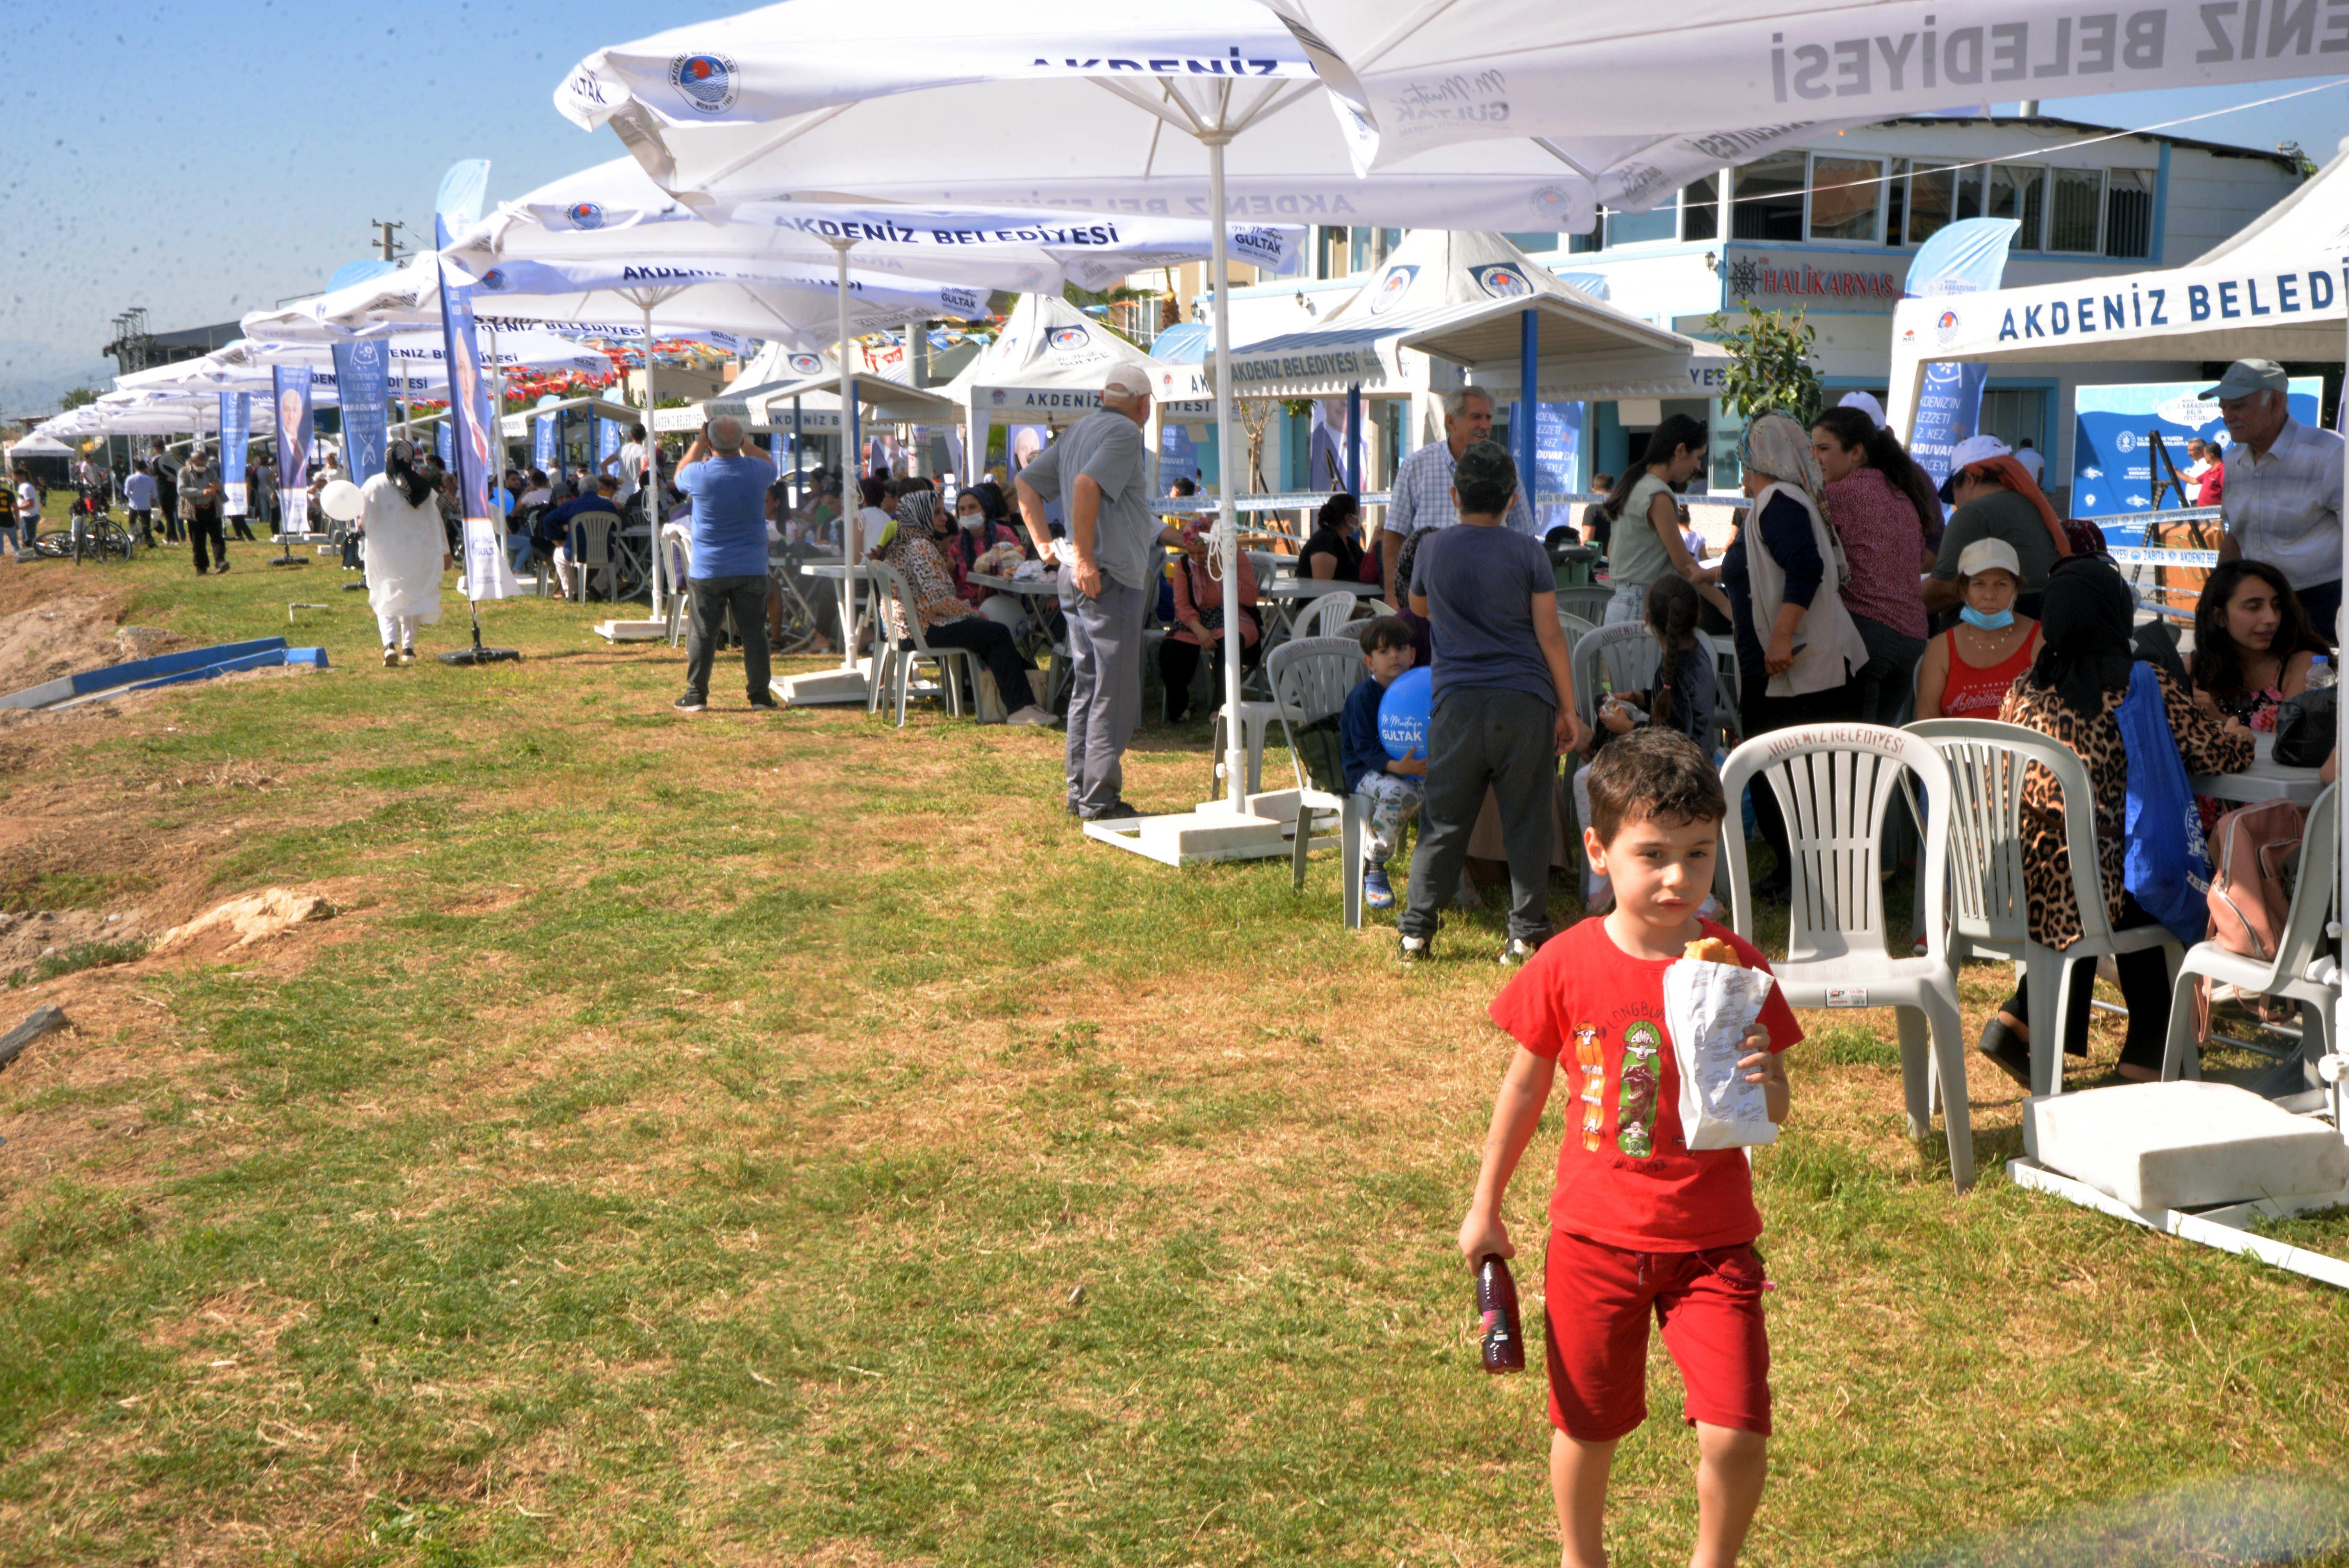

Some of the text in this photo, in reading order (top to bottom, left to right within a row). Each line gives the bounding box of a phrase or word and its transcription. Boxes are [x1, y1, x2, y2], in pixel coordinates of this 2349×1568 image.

[695, 100, 720, 111] MERSİN
[775, 216, 1120, 245] AKDENİZ BELEDİYESİ
[1764, 265, 1894, 298] HALİKARNAS
[1998, 282, 2169, 342] AKDENİZ
[1231, 351, 1360, 382] AKDENİZ BELEDİYESİ
[1025, 392, 1102, 407] AKDENİZ
[655, 413, 703, 428] AKDENİZ BELEDİYES
[768, 413, 826, 426] AKDNİZ
[1916, 412, 1952, 425] LEZZETİ
[1537, 425, 1561, 435] EZZETİ
[1916, 427, 1946, 440] 2. KEZ
[1543, 438, 1558, 447] KEZ
[1563, 494, 1581, 502] AKDENİZ
[2144, 549, 2165, 561] ZABITA
[2180, 551, 2206, 563] AKDENİZ
